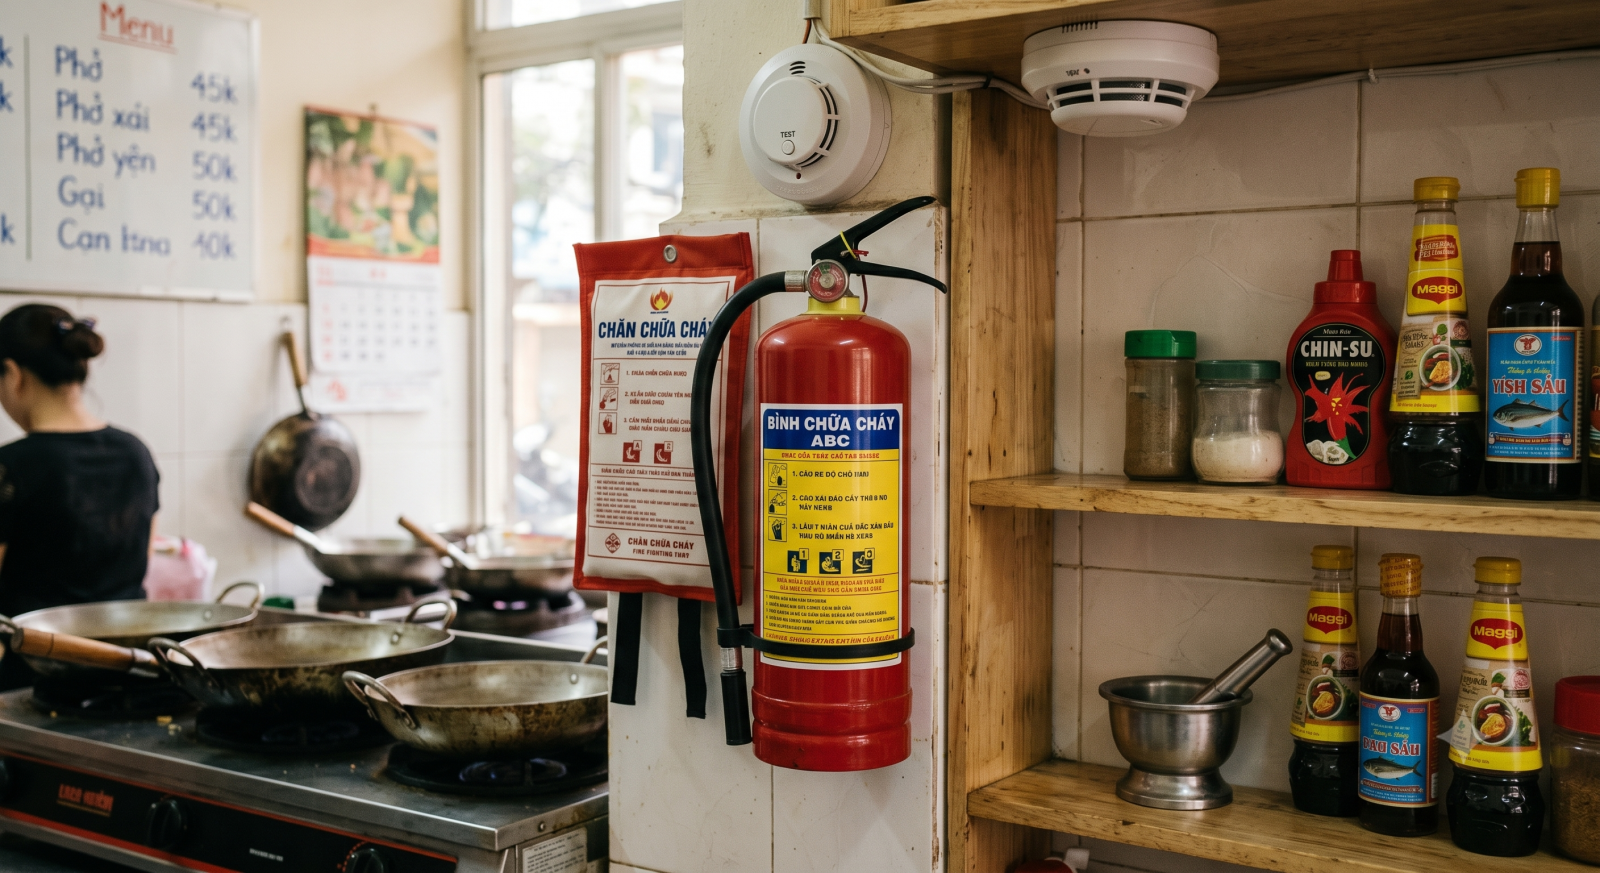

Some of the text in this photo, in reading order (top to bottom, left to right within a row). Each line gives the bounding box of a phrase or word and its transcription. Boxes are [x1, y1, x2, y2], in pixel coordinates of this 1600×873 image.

[99, 2, 175, 45] Menu
[191, 72, 237, 104] 45k
[191, 113, 237, 142] 45k
[192, 151, 236, 182] 50k
[192, 190, 236, 221] 50k
[1417, 284, 1458, 295] Maggi
[598, 318, 636, 338] CHĂN
[640, 317, 677, 338] CHỮA
[1300, 340, 1373, 358] CHIN-SU
[768, 412, 895, 431] BÌNH CHỮA CHÁY
[811, 435, 850, 447] ABC
[802, 550, 806, 558] 1
[835, 551, 841, 559] 2
[1308, 612, 1348, 625] Maggi
[1474, 625, 1518, 639] Maggi
